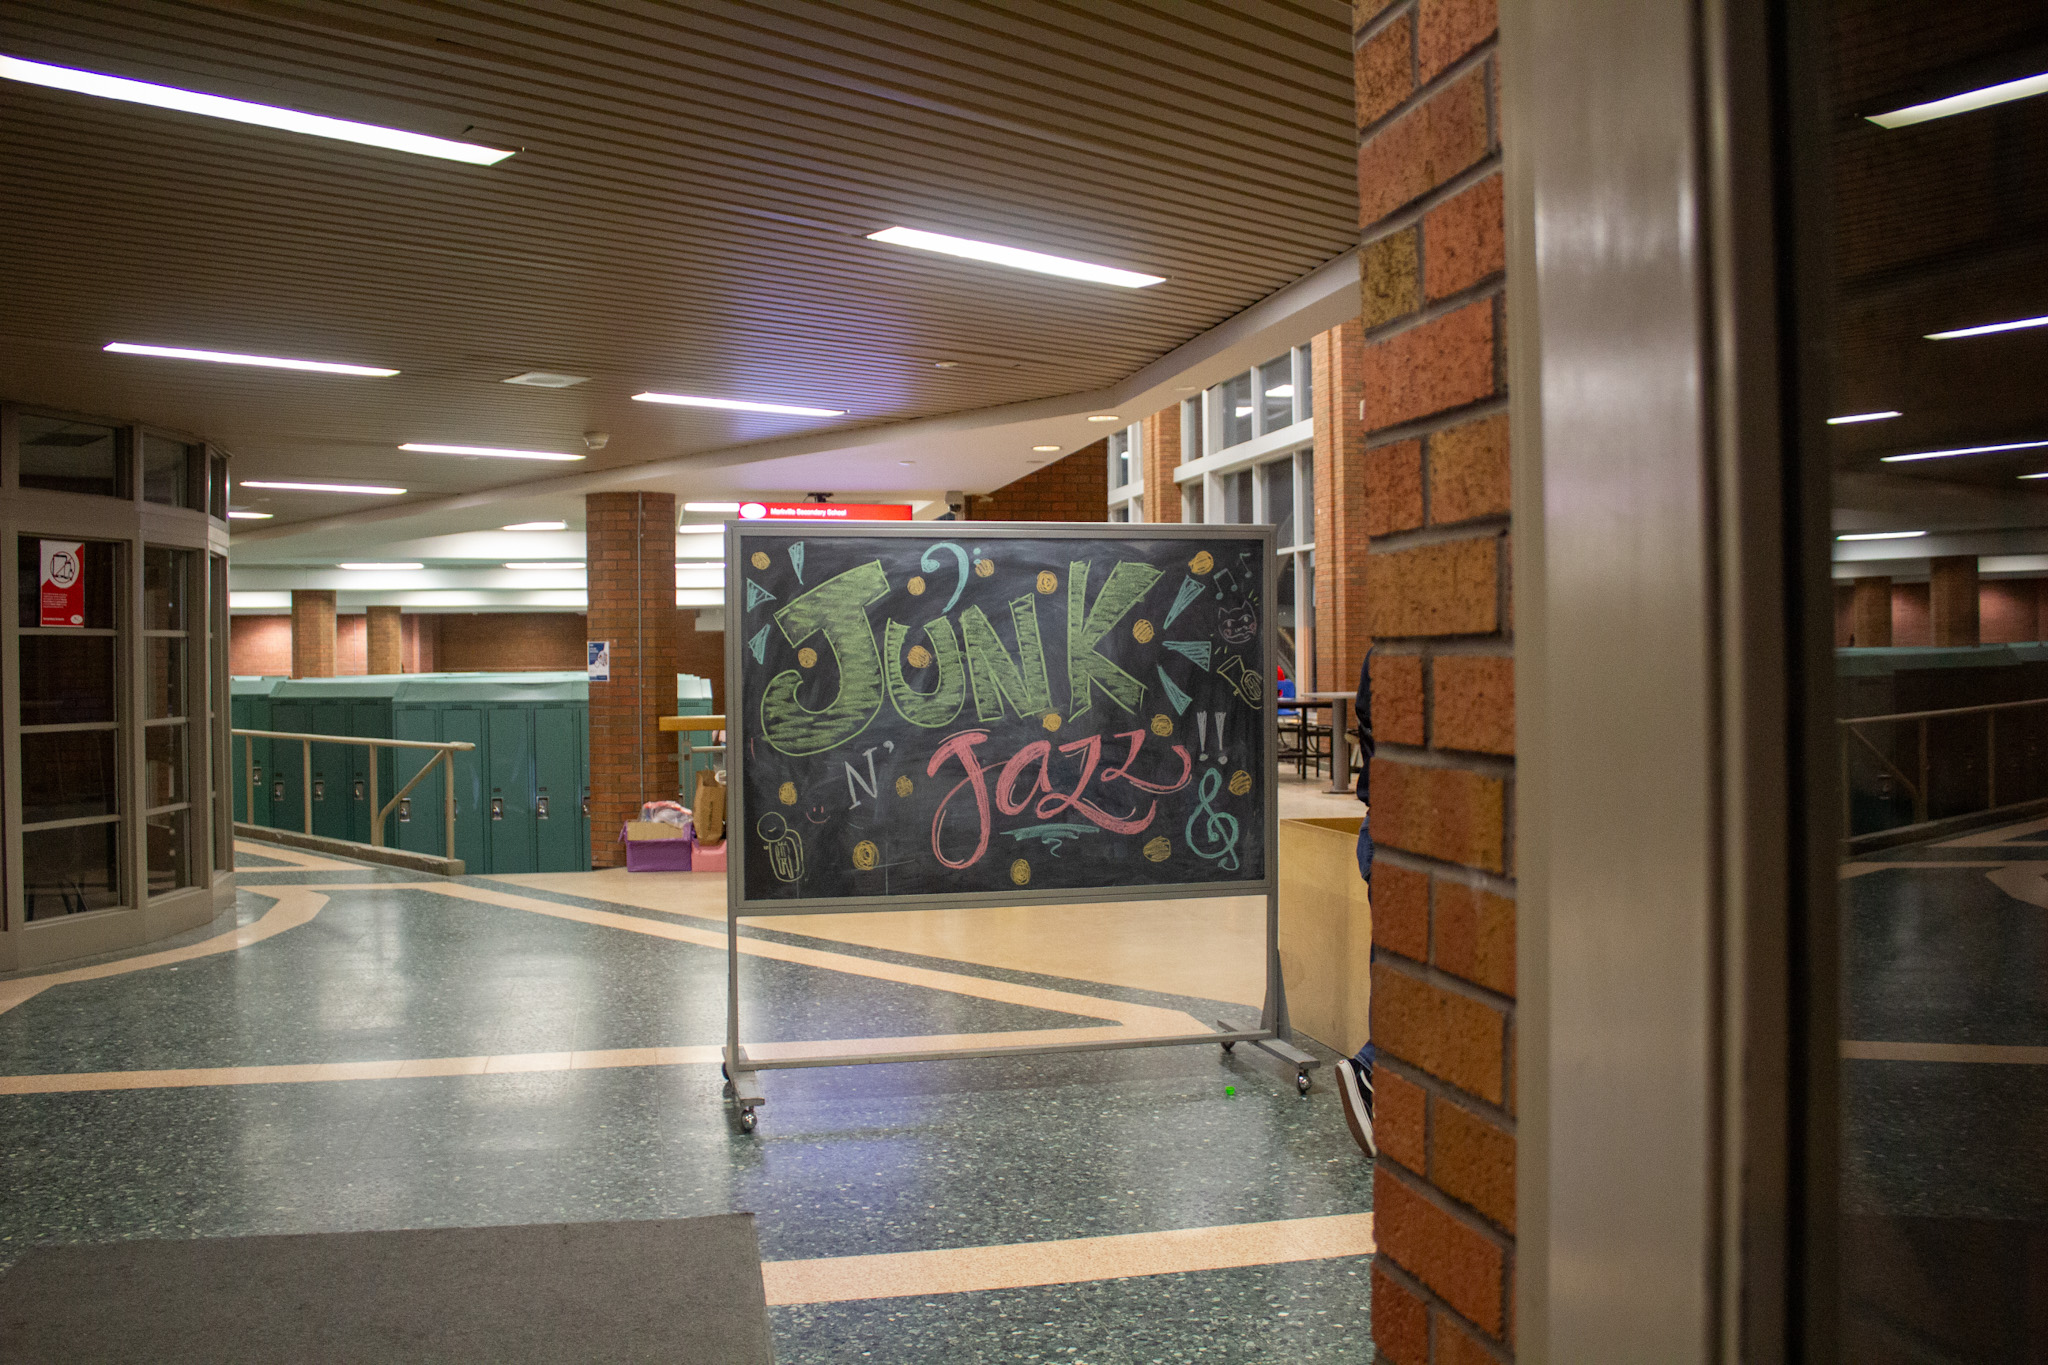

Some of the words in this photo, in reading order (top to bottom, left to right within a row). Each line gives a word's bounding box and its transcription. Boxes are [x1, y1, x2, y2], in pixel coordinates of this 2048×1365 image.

[796, 508, 827, 517] Secondary
[826, 508, 847, 516] School
[761, 559, 1165, 756] JUNK
